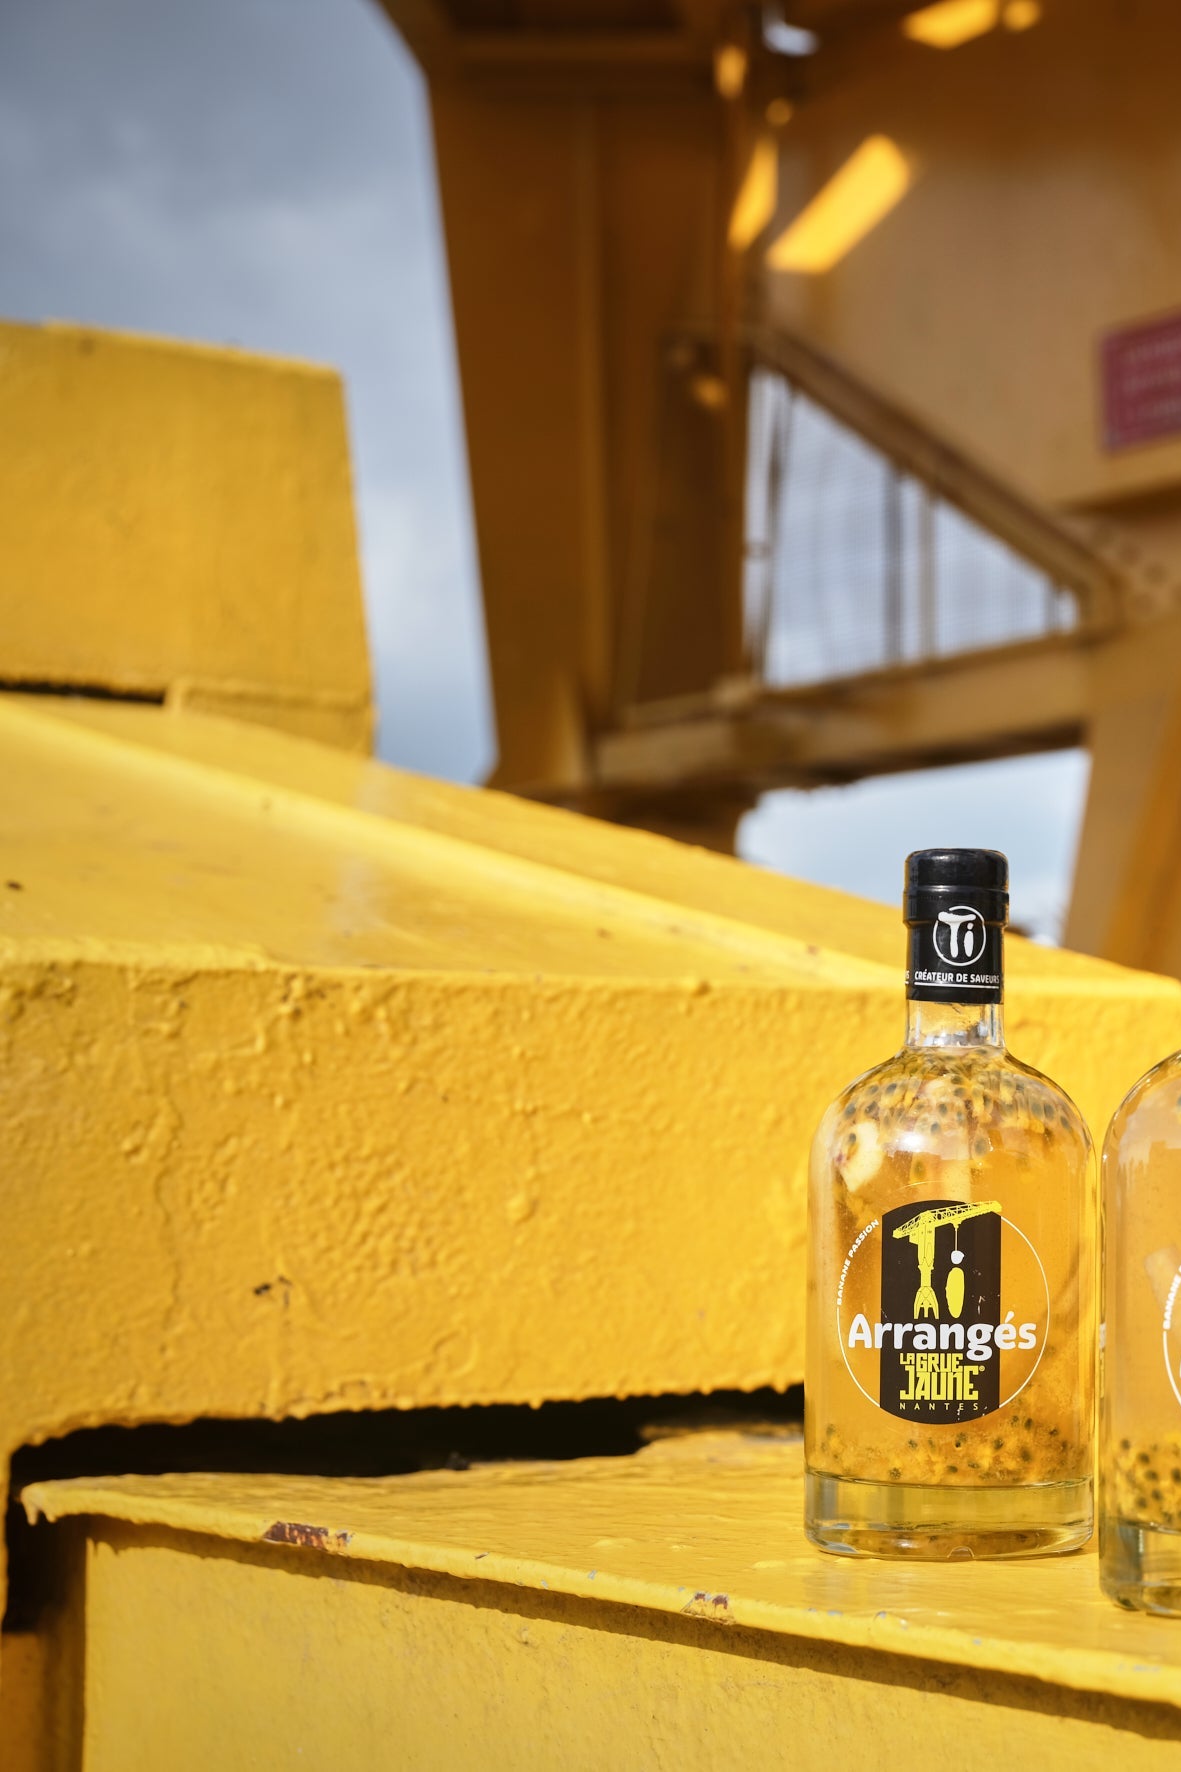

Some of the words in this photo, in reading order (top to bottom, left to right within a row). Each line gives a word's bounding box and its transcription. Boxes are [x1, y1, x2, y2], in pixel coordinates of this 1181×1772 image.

[938, 911, 976, 958] Ti
[914, 969, 955, 983] CRÉATEUR
[956, 972, 968, 983] DE
[970, 974, 1000, 984] SAVEURS
[837, 1260, 852, 1306] BANANE
[849, 1218, 880, 1259] PASSION
[848, 1311, 1037, 1361] Arrangés
[900, 1353, 915, 1365] LA
[916, 1353, 963, 1372] GRUE
[900, 1402, 979, 1411] NANTES
